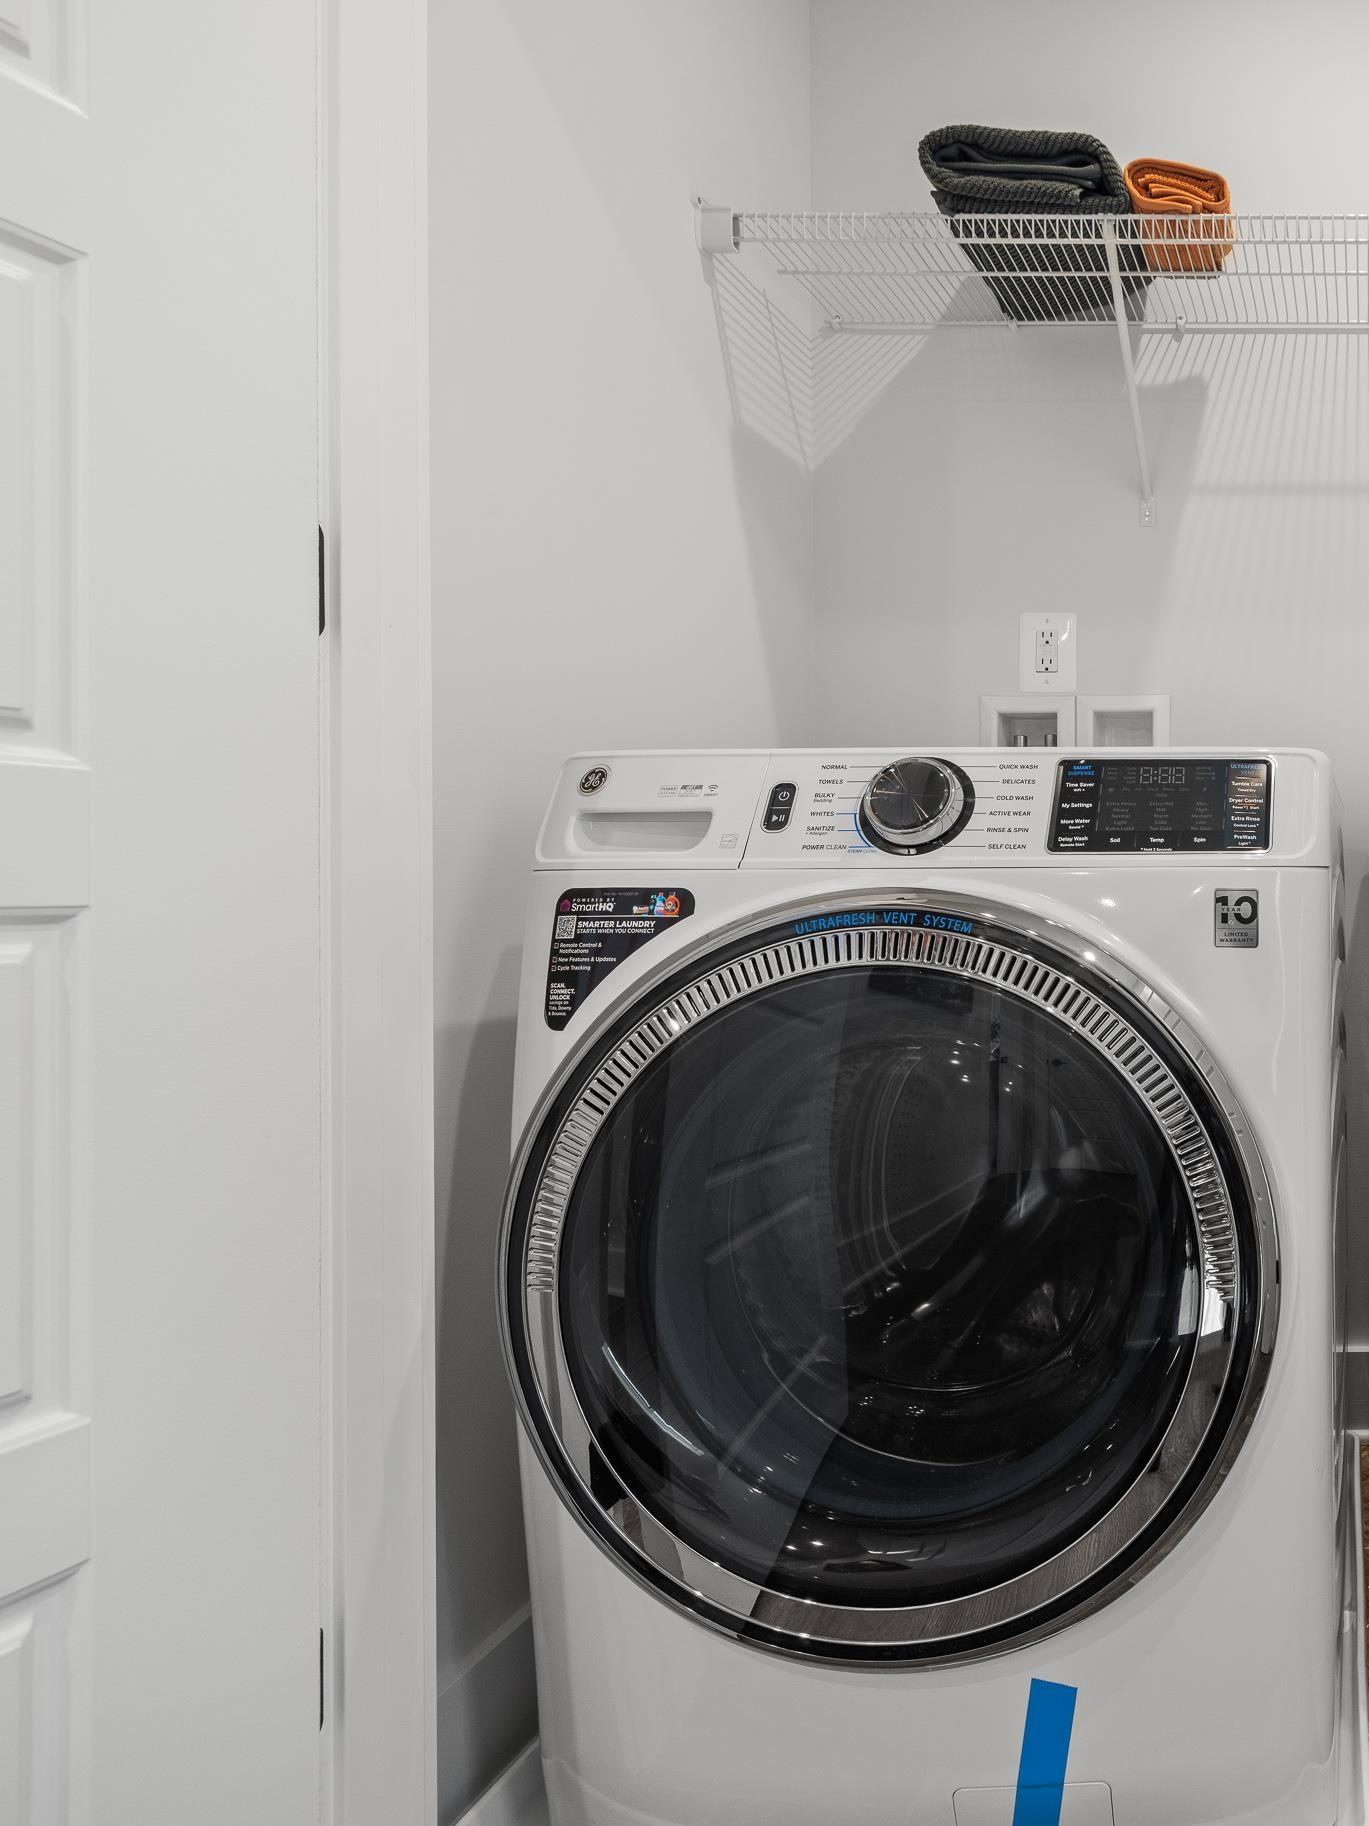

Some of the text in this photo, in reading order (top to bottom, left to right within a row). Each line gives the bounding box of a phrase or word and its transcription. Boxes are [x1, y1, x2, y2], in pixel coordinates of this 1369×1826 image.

[1215, 895, 1258, 925] 10
[615, 920, 656, 928] LAUNDRY
[794, 911, 973, 935] ULTRAFRESH VENT SYSTEM
